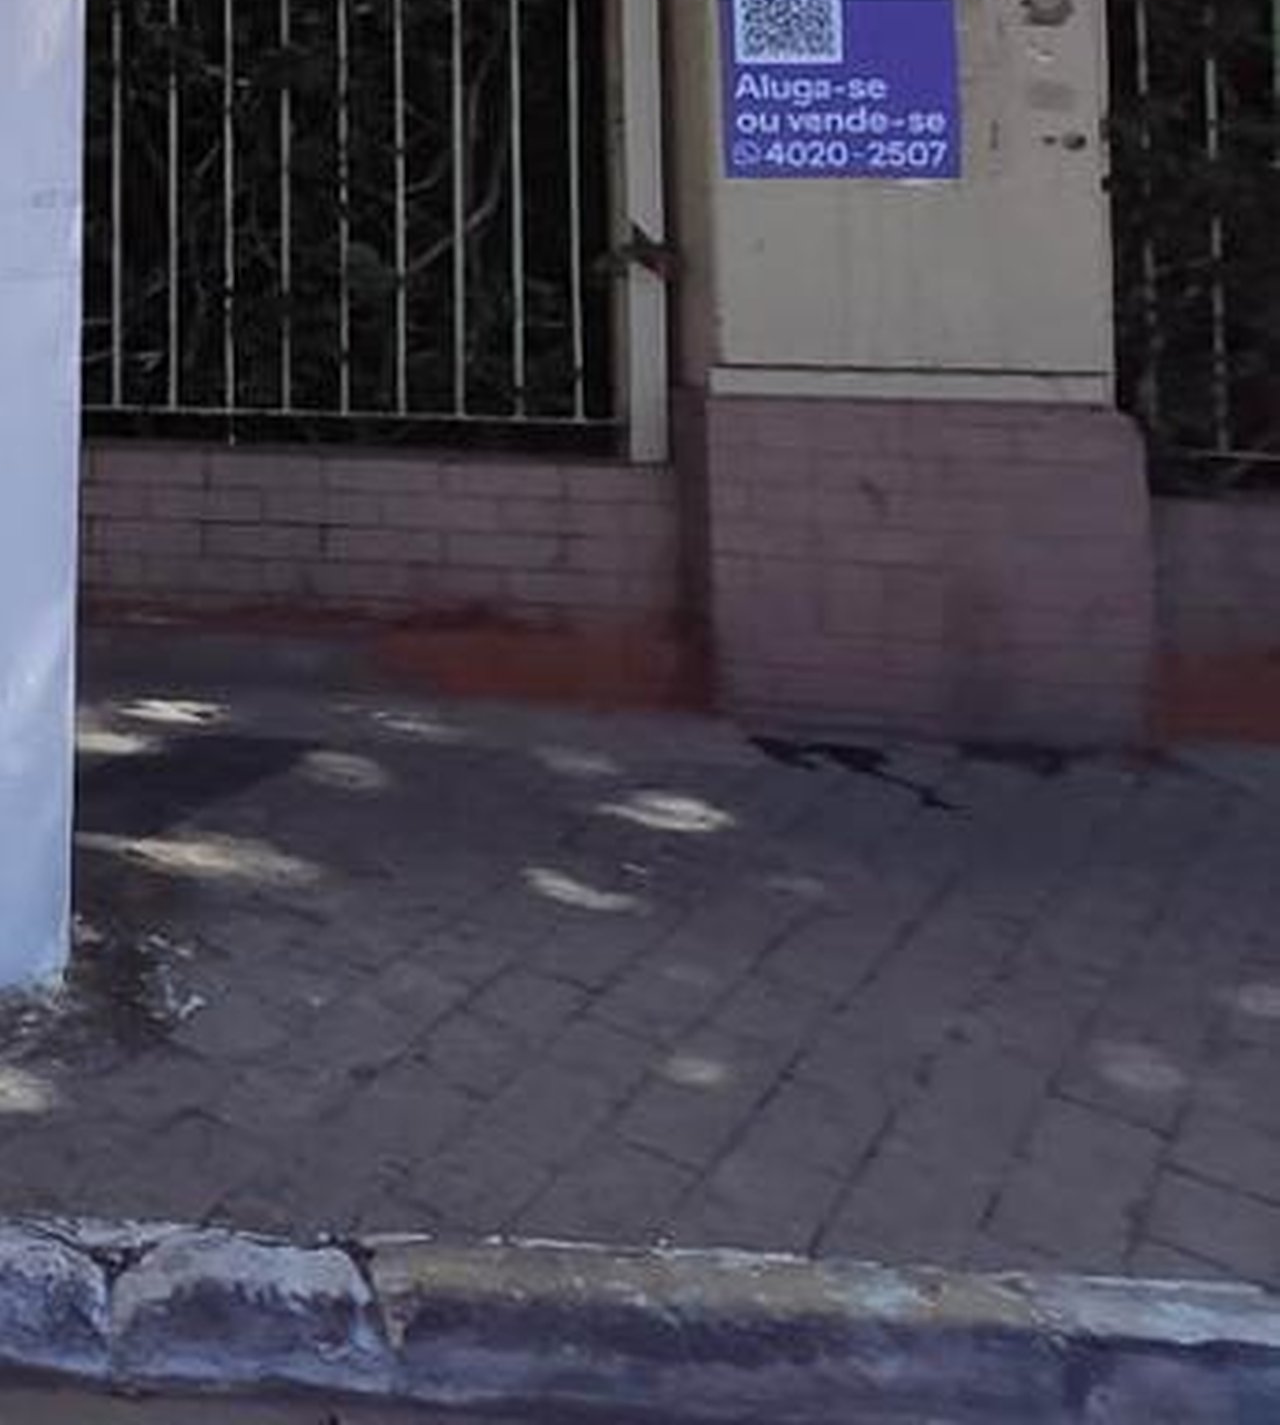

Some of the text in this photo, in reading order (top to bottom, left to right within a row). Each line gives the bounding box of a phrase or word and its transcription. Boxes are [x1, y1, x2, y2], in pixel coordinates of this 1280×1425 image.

[735, 73, 887, 107] Aluga-se
[736, 107, 946, 134] ou vende-se
[764, 140, 947, 167] 4020-2507
